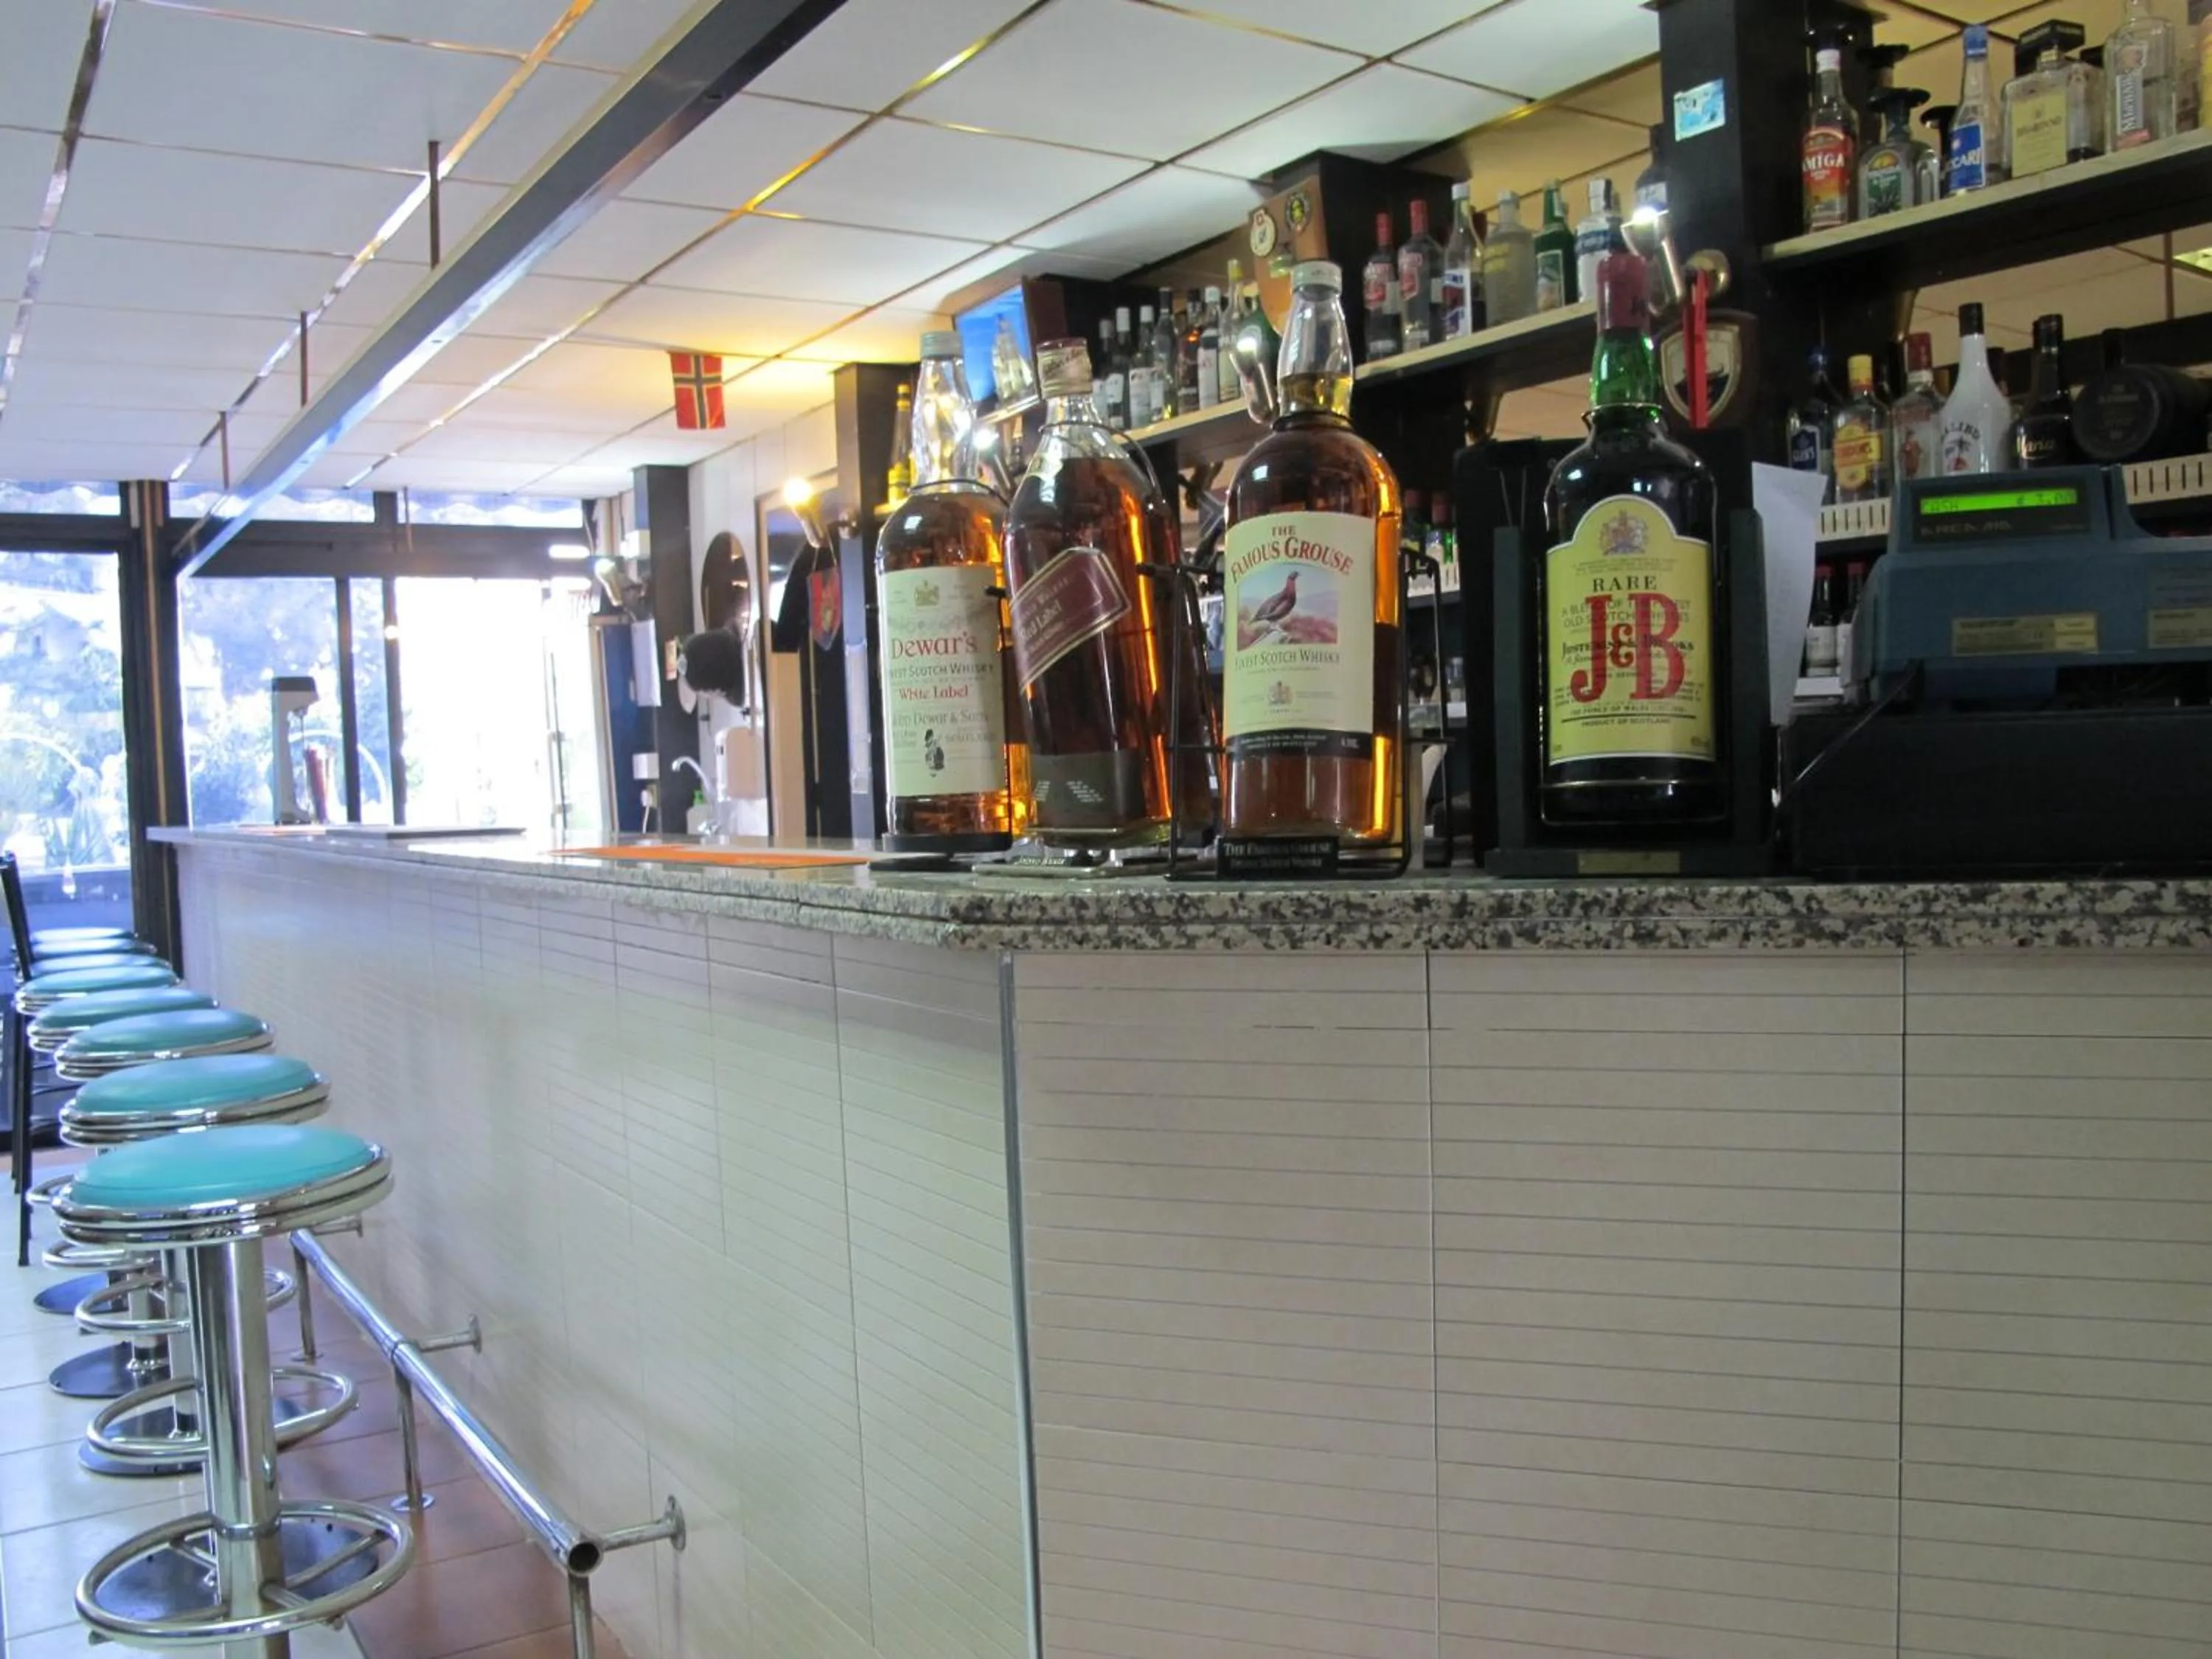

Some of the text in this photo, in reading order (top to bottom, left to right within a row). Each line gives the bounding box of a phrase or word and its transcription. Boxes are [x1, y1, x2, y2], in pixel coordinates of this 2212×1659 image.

[1272, 525, 1296, 536] THE
[1231, 536, 1354, 583] FAMOUS GROUSE
[1593, 575, 1657, 592] RARE
[892, 631, 978, 659] Dewar's
[1570, 592, 1686, 703] J&B
[1260, 650, 1297, 666] SCOTCH
[908, 664, 947, 678] SCOTCH
[950, 663, 994, 674] WHISKY
[933, 684, 968, 700] Label
